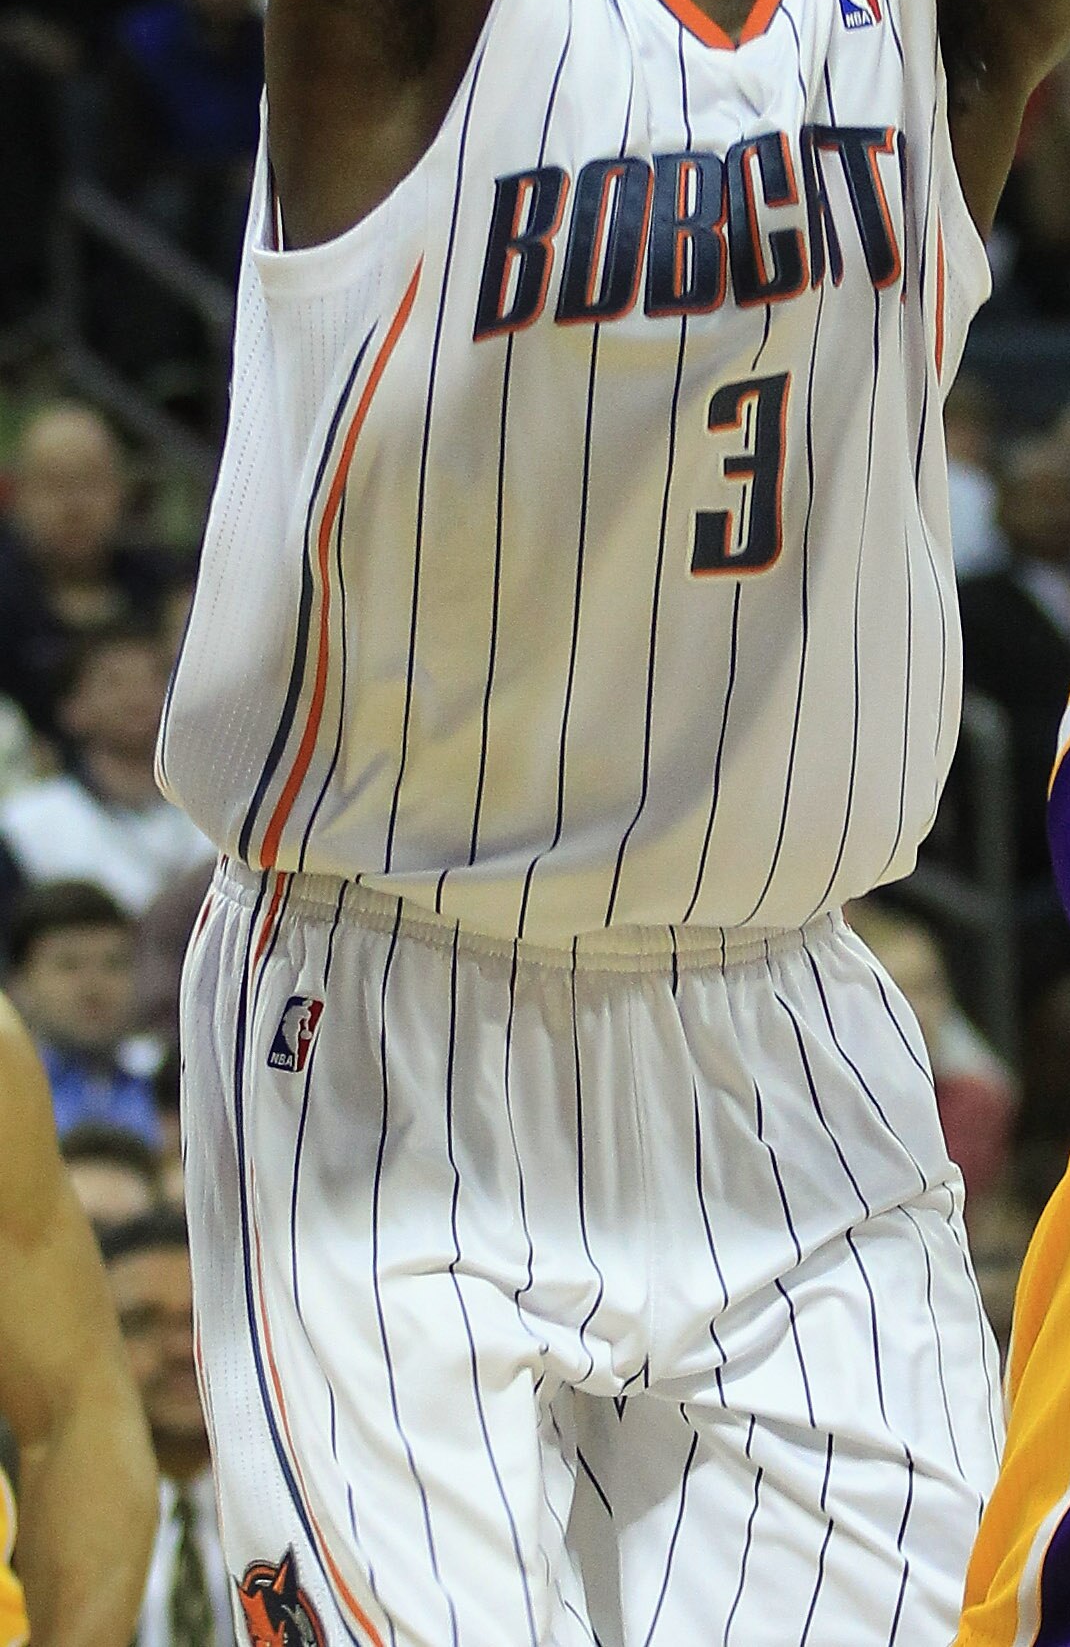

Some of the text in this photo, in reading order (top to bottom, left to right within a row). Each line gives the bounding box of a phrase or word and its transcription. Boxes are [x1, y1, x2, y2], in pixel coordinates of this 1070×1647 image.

[473, 124, 907, 342] BOBCAT
[690, 370, 791, 577] 3
[270, 1052, 293, 1067] NBA
